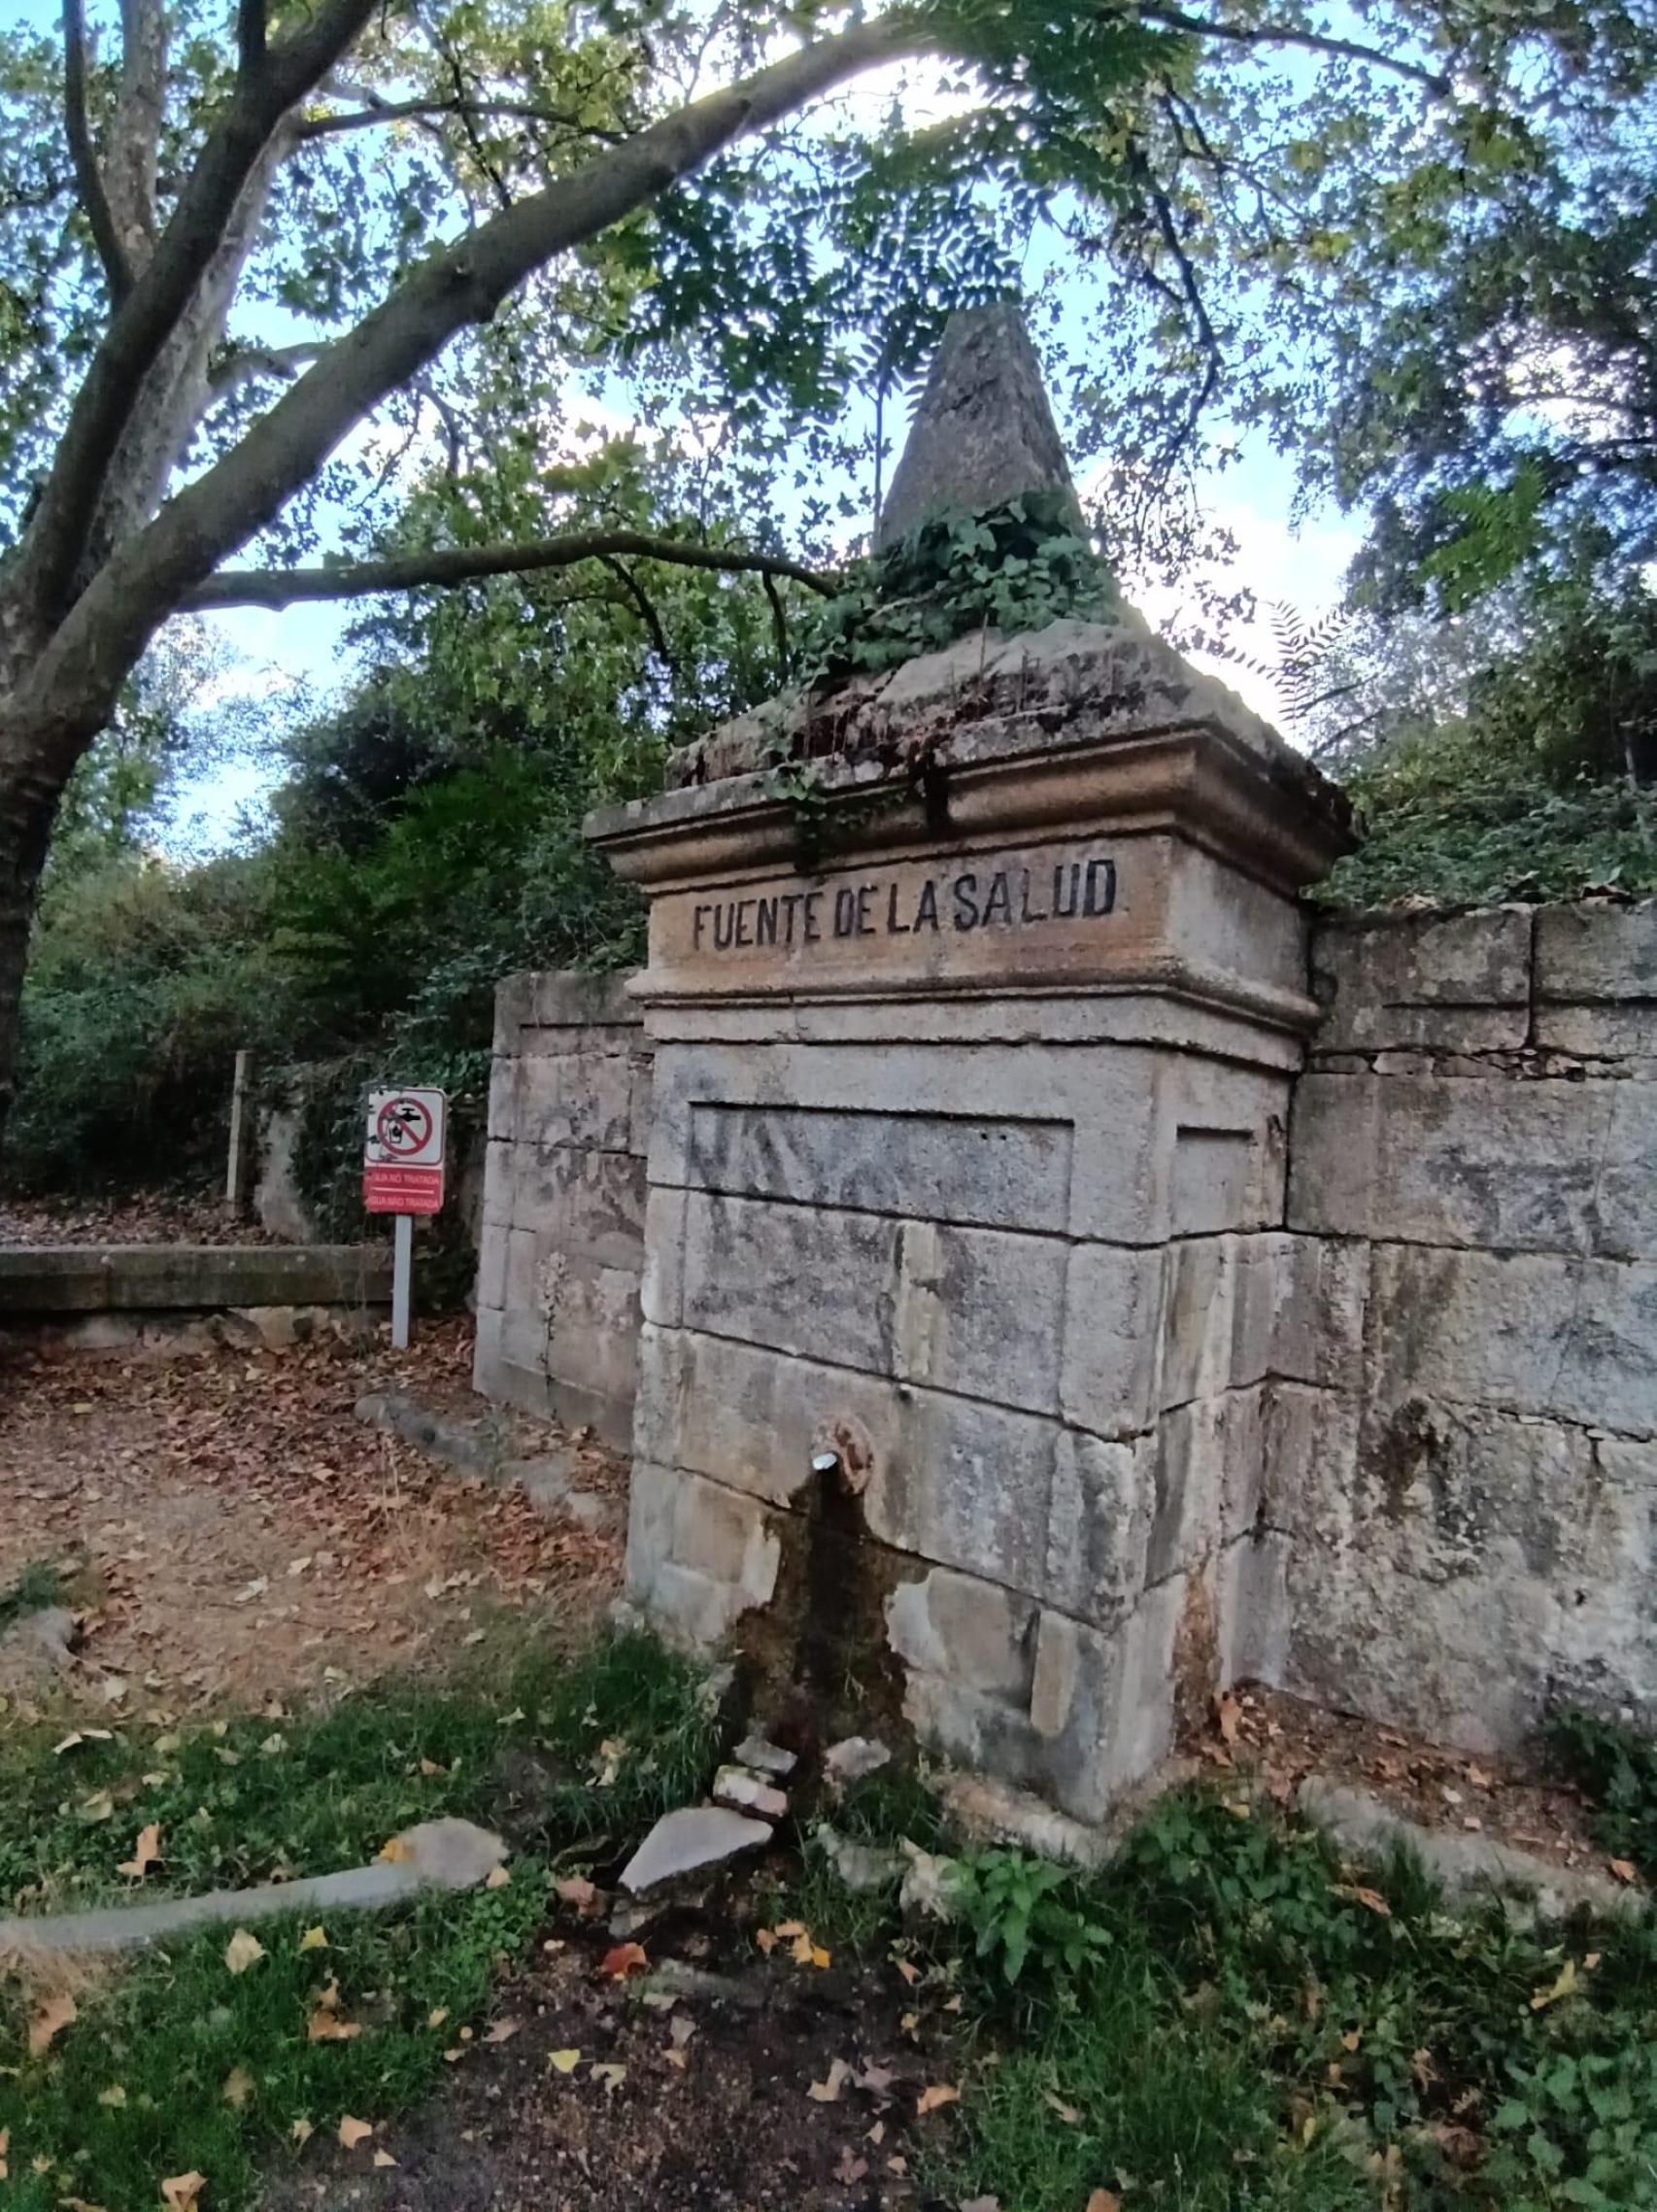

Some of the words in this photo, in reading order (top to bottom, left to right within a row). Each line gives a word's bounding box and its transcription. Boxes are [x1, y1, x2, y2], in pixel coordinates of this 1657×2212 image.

[693, 894, 823, 950] FUENTE
[833, 885, 878, 937] DE
[887, 879, 940, 935] LA
[952, 859, 1116, 931] SALUD
